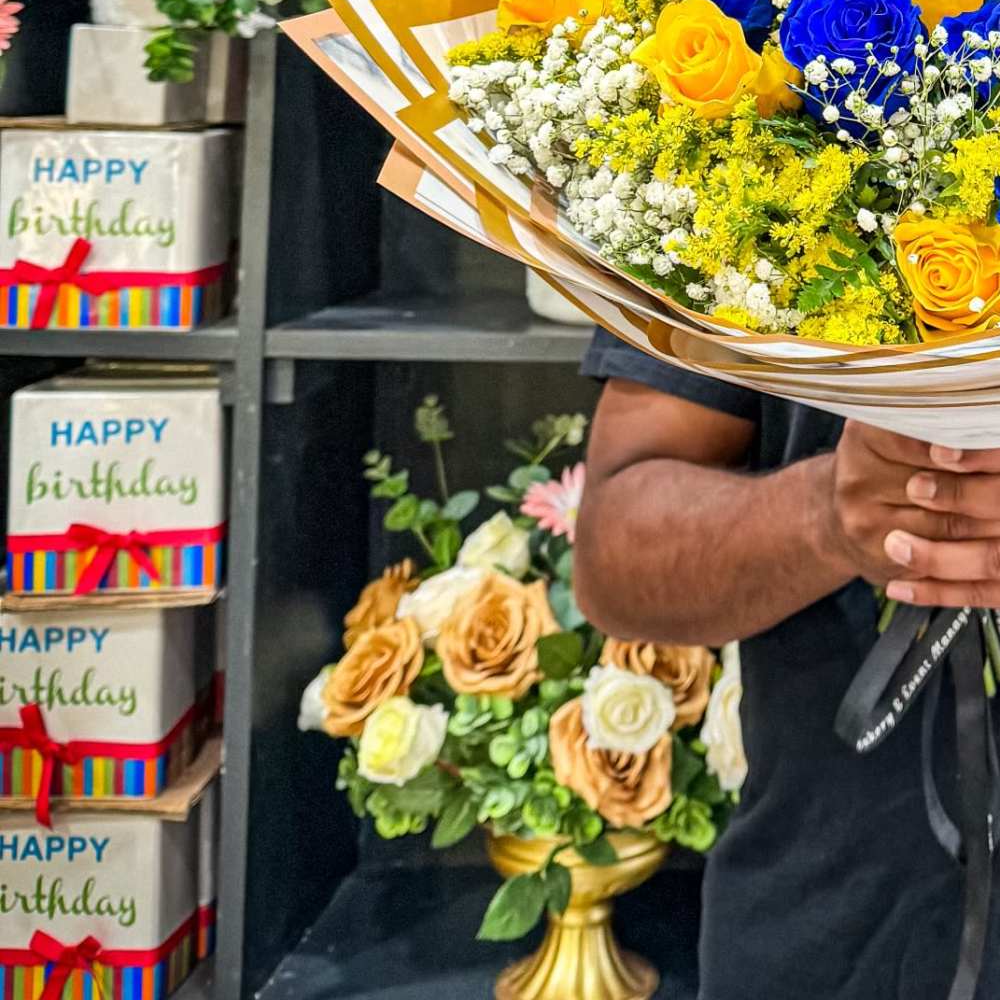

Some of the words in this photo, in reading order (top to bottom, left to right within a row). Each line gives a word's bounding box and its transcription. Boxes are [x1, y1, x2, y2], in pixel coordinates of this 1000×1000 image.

[33, 157, 149, 185] HAPPY
[8, 197, 176, 247] birthday
[51, 418, 169, 447] HAPPY
[26, 459, 198, 505] birthday
[0, 627, 109, 653] HAPPY
[901, 659, 932, 700] Event
[0, 835, 110, 863] HAPPY
